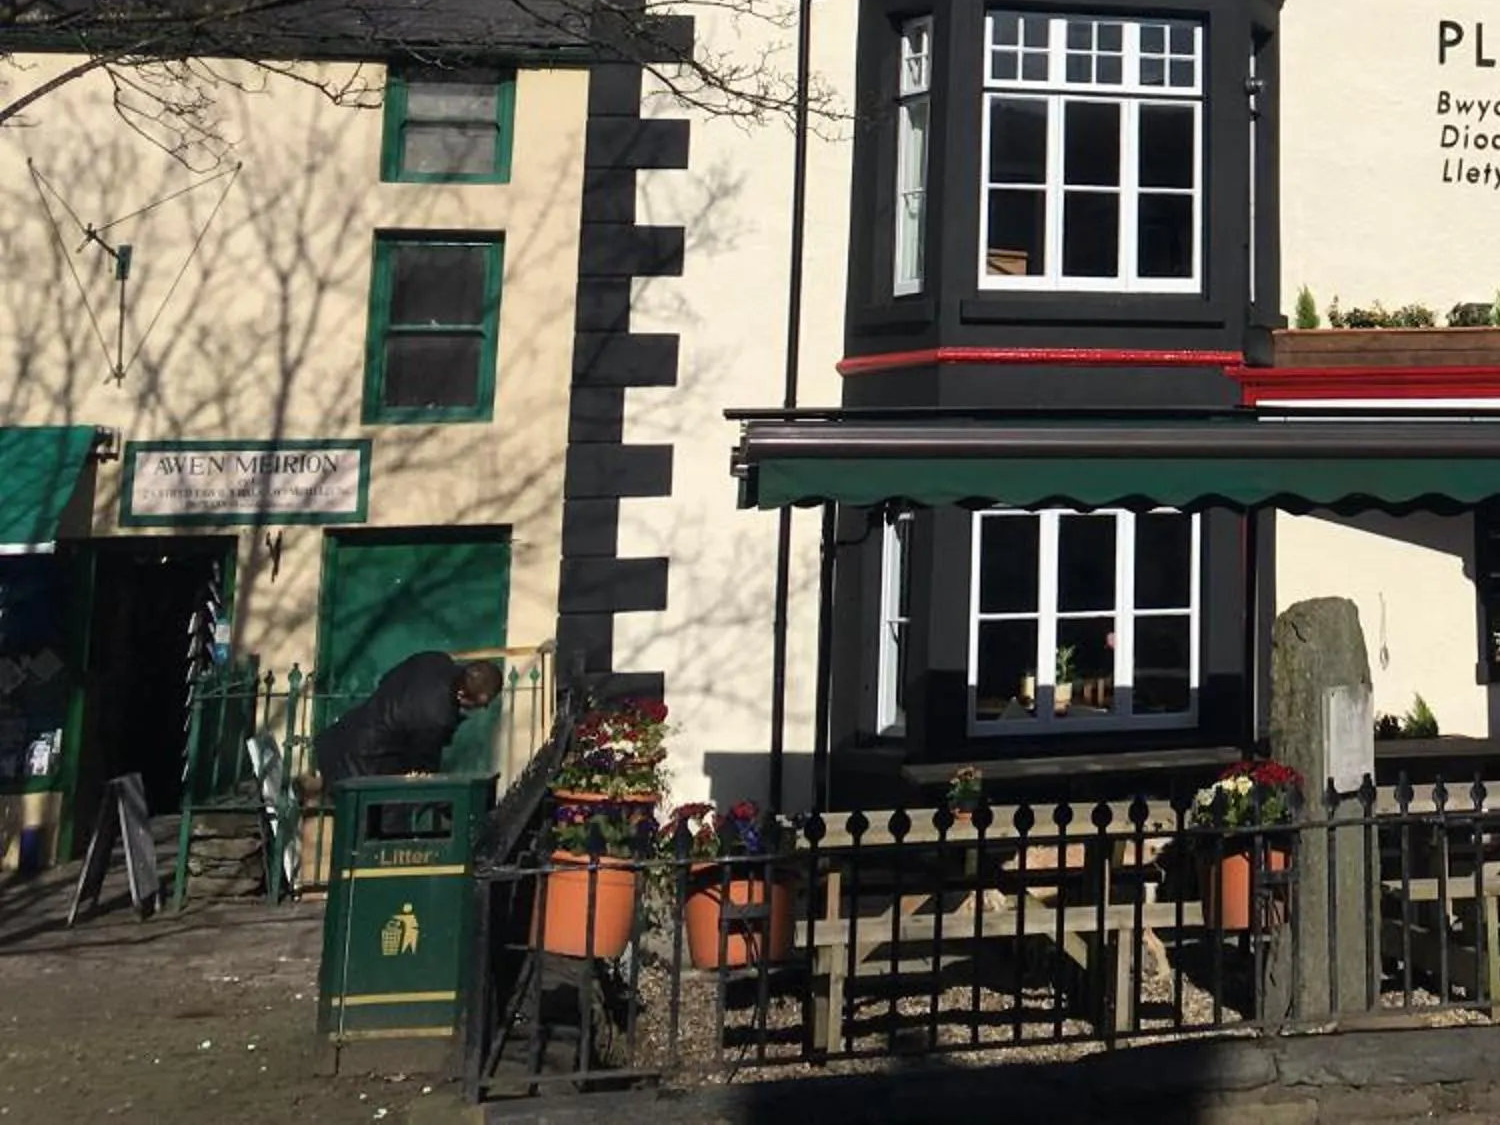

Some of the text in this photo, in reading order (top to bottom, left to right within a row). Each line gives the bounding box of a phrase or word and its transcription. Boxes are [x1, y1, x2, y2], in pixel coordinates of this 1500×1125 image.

[155, 453, 338, 475] AWEN MEIRION
[380, 849, 431, 865] Litter
